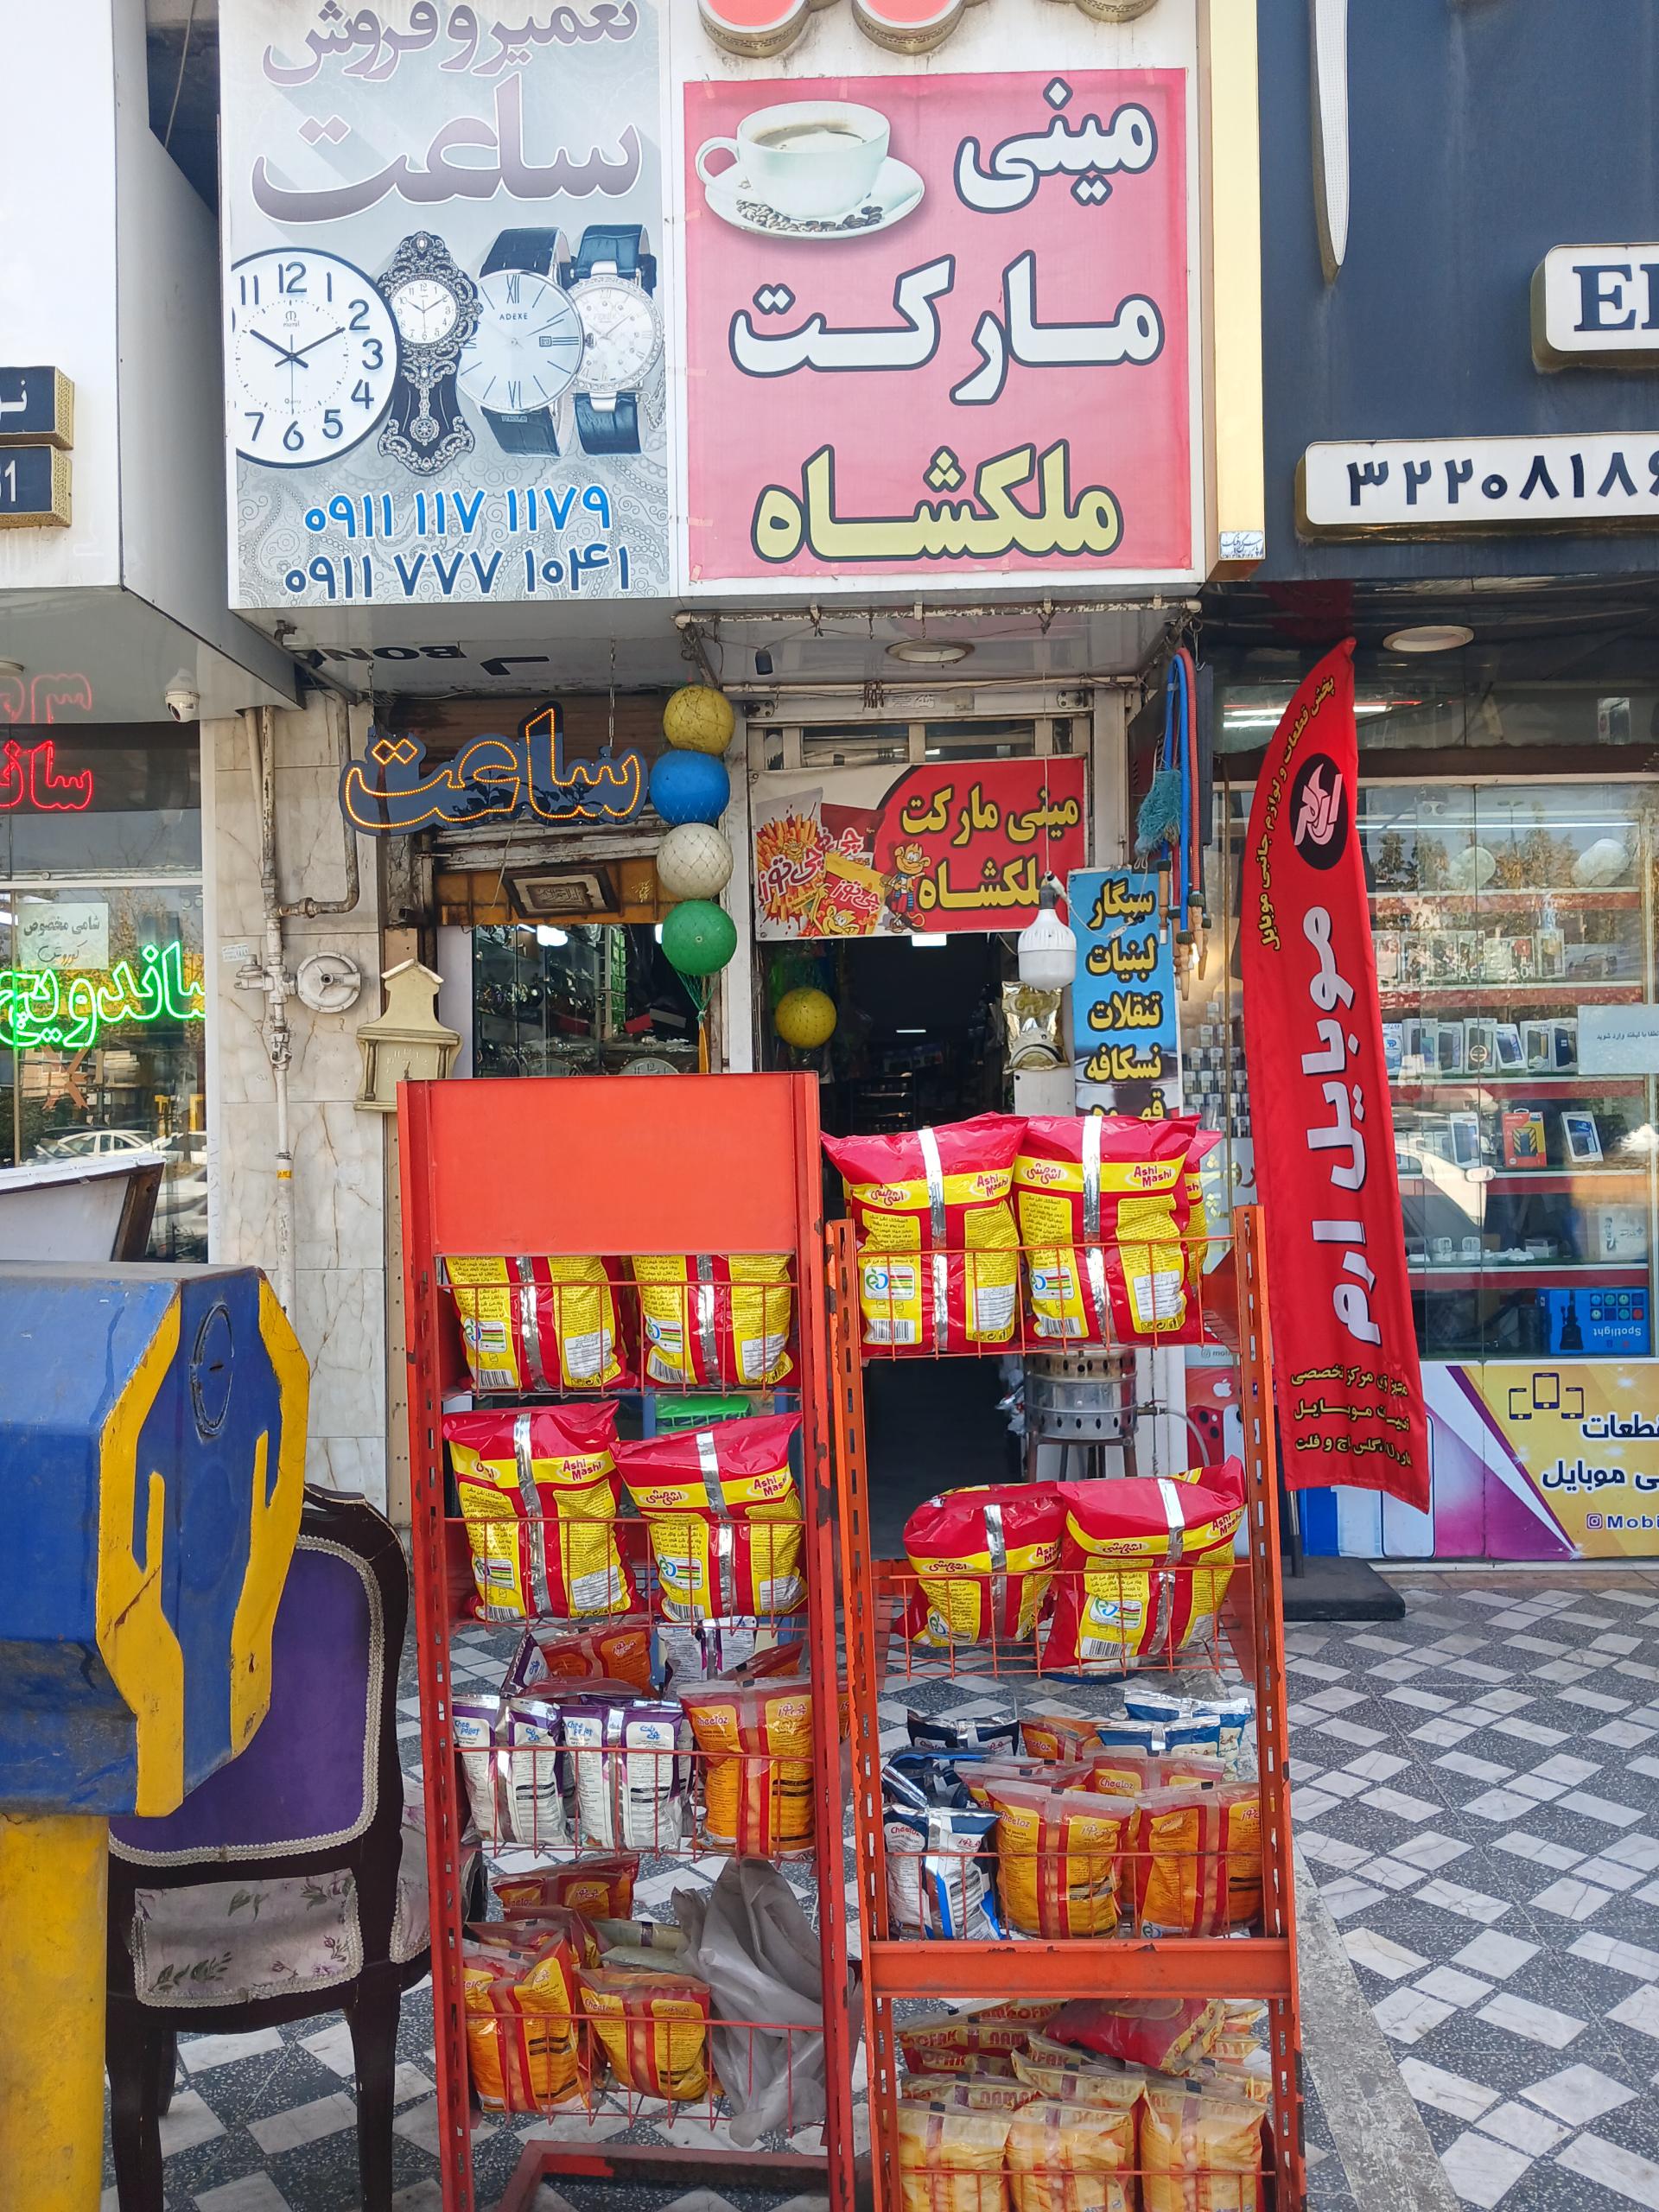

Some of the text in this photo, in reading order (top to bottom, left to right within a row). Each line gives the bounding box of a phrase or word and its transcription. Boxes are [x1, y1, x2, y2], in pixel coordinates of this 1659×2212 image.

[263, 0, 438, 86] فروش
[440, 3, 477, 71] و
[252, 72, 640, 225] ساعت
[953, 77, 1158, 215] مینی
[240, 275, 259, 305] 11
[278, 262, 307, 293] 12
[327, 271, 333, 302] 1
[348, 299, 371, 330] 2
[728, 248, 1164, 405] مارکت
[362, 338, 384, 370] 3
[351, 378, 374, 409] 4
[245, 412, 264, 442] 7
[283, 420, 304, 451] 6
[322, 409, 343, 439] 5
[304, 484, 612, 539] ۰۹۱۱ ۱۱۷ ۱۱۷۹
[750, 438, 1123, 563] ملکشاه
[284, 543, 631, 600] ۰۹۱۱ ۷۷۷ ۱۰۴۱
[342, 703, 646, 834] ساعت
[901, 782, 999, 846] مارکت
[1007, 788, 1080, 842] مینی
[1088, 881, 1154, 929] سیگار
[1257, 893, 1281, 951] موبایل
[1086, 936, 1158, 982] لبنیات
[1088, 991, 1163, 1030] تنقلات
[1086, 1044, 1163, 1081] نسکافه
[1299, 906, 1368, 1191] موبایل
[976, 1173, 999, 1187] Ashi
[986, 1178, 1008, 1197] Mashi
[1133, 1166, 1158, 1178] Ashi
[1142, 1171, 1172, 1187] Mashi
[1593, 1326, 1642, 1337] Spotlight
[563, 1459, 586, 1471] Ashi
[572, 1462, 601, 1481] Mashi
[1542, 1460, 1625, 1491] موبایل
[753, 1475, 777, 1490] Ashi
[1211, 1514, 1231, 1531] Ashi
[1100, 1777, 1134, 1790] Cheetoz
[1000, 1811, 1030, 1827] Cheetoz
